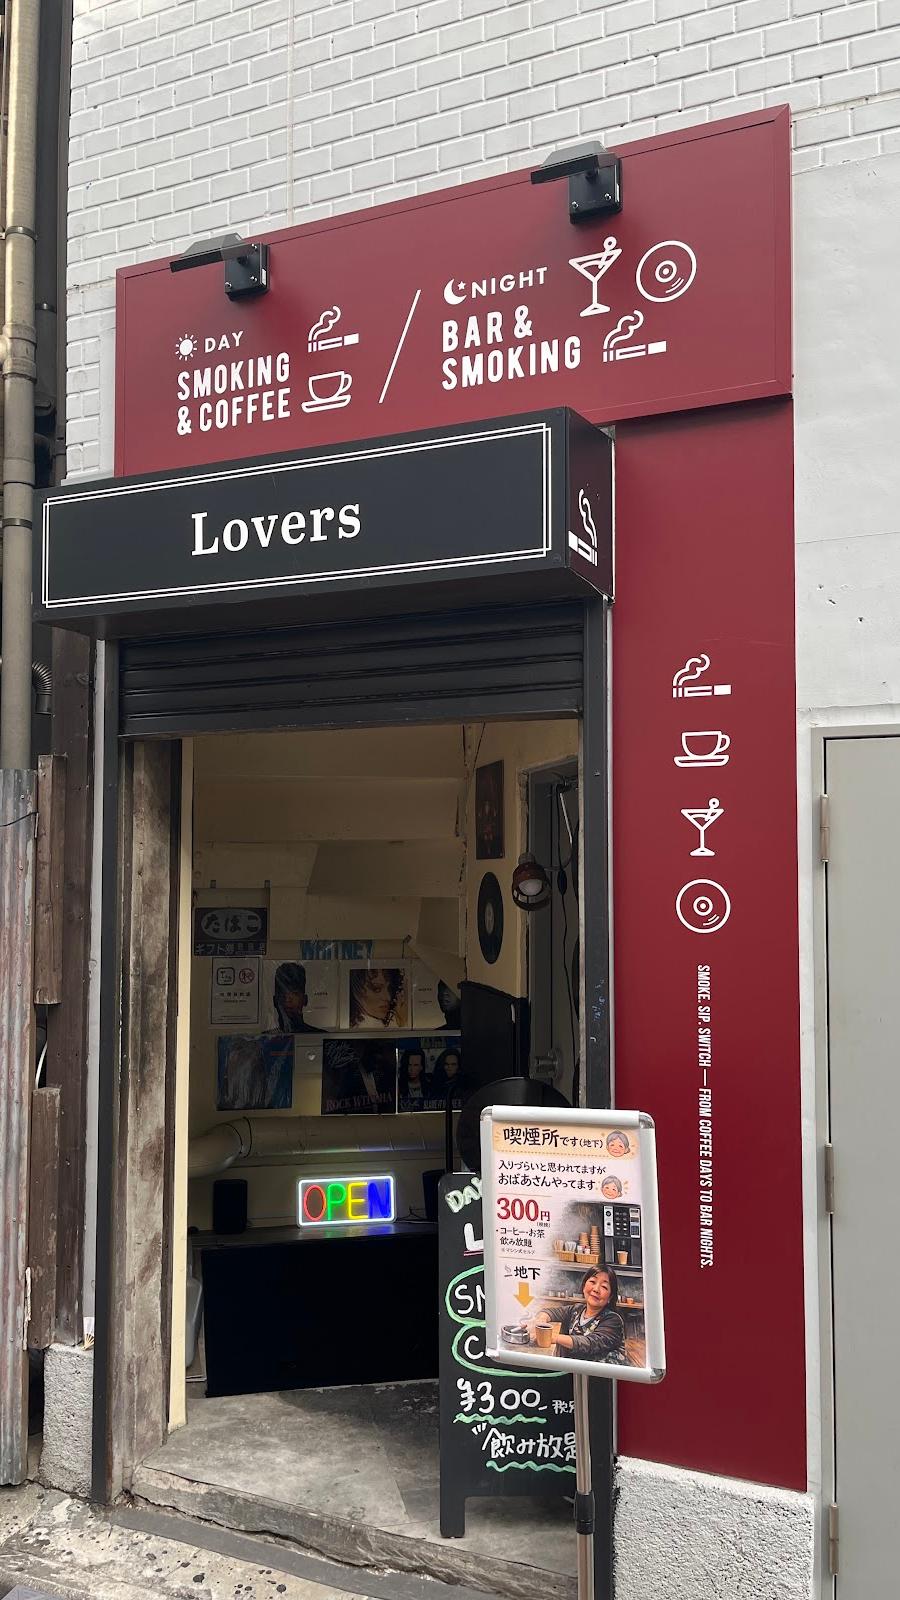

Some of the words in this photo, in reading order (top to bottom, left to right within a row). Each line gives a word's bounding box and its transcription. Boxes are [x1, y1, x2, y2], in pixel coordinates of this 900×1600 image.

[471, 266, 548, 299] NIGHT
[204, 331, 244, 353] DAY
[442, 312, 504, 352] BAR
[513, 305, 533, 339] &
[177, 352, 291, 401] SMOKING
[441, 337, 581, 390] SMOKING
[177, 407, 193, 436] &
[199, 388, 291, 432] COFFEE
[191, 502, 363, 556] Lovers
[697, 965, 710, 1003] SMOKE.
[697, 1006, 710, 1025] SIP.
[698, 1028, 712, 1067] SWITCH
[699, 1089, 711, 1117] FROM
[503, 1127, 603, 1149] 喫煙所です(地下)
[699, 1120, 712, 1158] COFFEE
[498, 1160, 606, 1175] 入りづらいと思われてますが
[498, 1173, 596, 1190] おばあさんやってます
[699, 1160, 713, 1187] DAYS
[303, 1182, 391, 1221] OPEN
[699, 1190, 712, 1203] TO
[700, 1205, 713, 1228] BAR
[500, 1237, 532, 1248] 飲み放題
[700, 1229, 713, 1269] NIGHTS.
[514, 1266, 541, 1280] 地下
